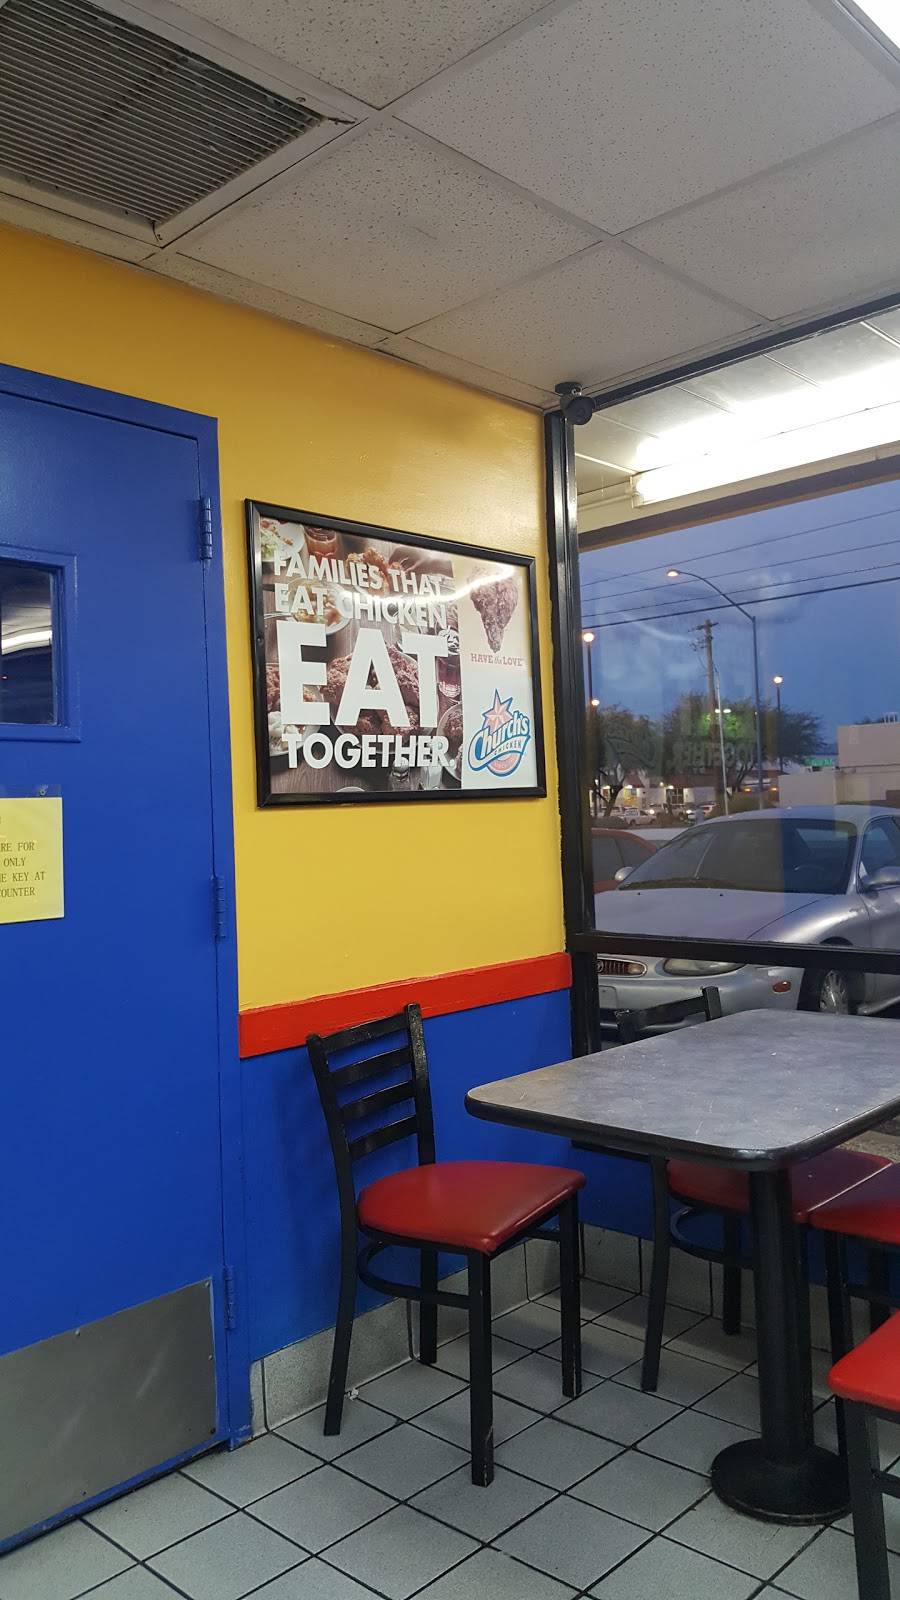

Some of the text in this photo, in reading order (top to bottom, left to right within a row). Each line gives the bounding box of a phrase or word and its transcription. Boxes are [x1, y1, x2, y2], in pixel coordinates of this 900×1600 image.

[274, 549, 442, 596] FAMILIES THAT
[274, 583, 448, 629] EAT CHICKEN
[471, 652, 494, 664] HAVE
[276, 619, 449, 728] EAT
[281, 733, 455, 769] TOGETHER.
[468, 710, 531, 771] Church's
[493, 740, 522, 756] CHICKEN
[0, 841, 35, 852] RE FOR
[3, 857, 26, 867] ONLY
[12, 872, 29, 882] KEY
[34, 871, 47, 881] AT
